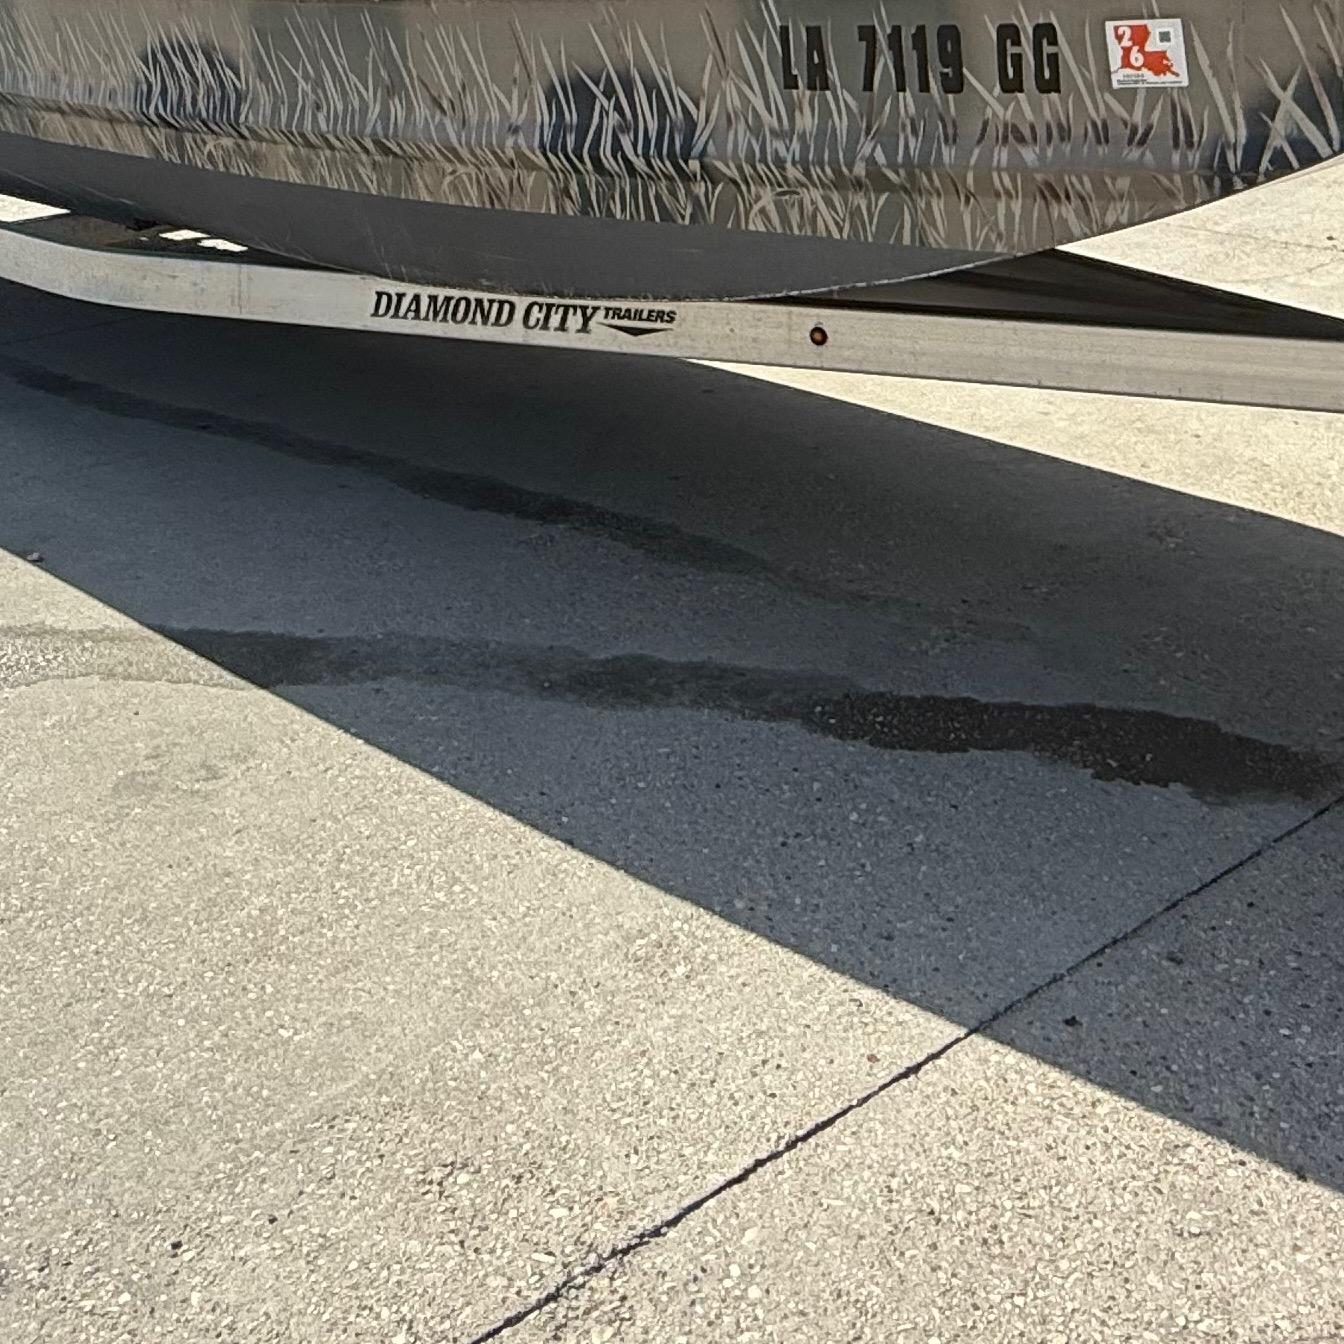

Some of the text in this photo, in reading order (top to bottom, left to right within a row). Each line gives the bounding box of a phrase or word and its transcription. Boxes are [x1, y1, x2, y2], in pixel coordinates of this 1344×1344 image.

[779, 22, 1061, 94] LA 7119 GG
[370, 290, 678, 334] DIAMOND CITY TRAILERS
